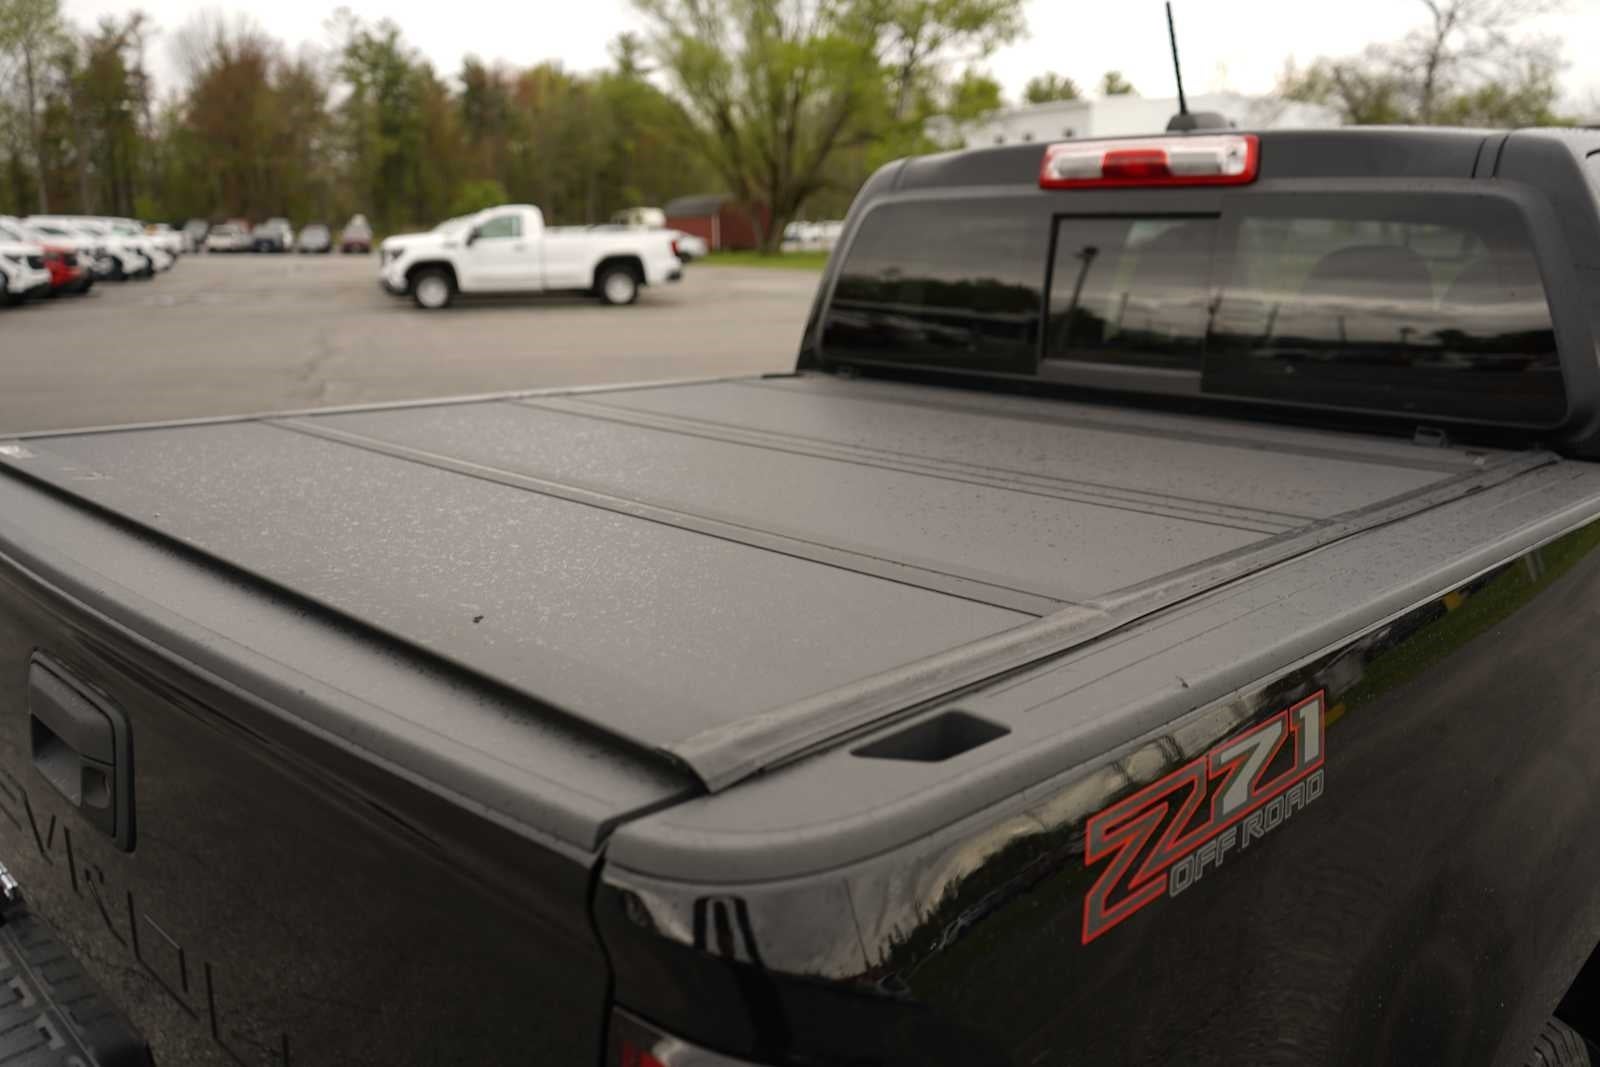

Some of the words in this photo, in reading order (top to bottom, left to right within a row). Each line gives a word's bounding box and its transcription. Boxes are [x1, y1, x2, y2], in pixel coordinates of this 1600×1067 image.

[1082, 689, 1325, 945] Z71
[1169, 827, 1237, 897] OFF
[1242, 768, 1325, 848] ROAD
